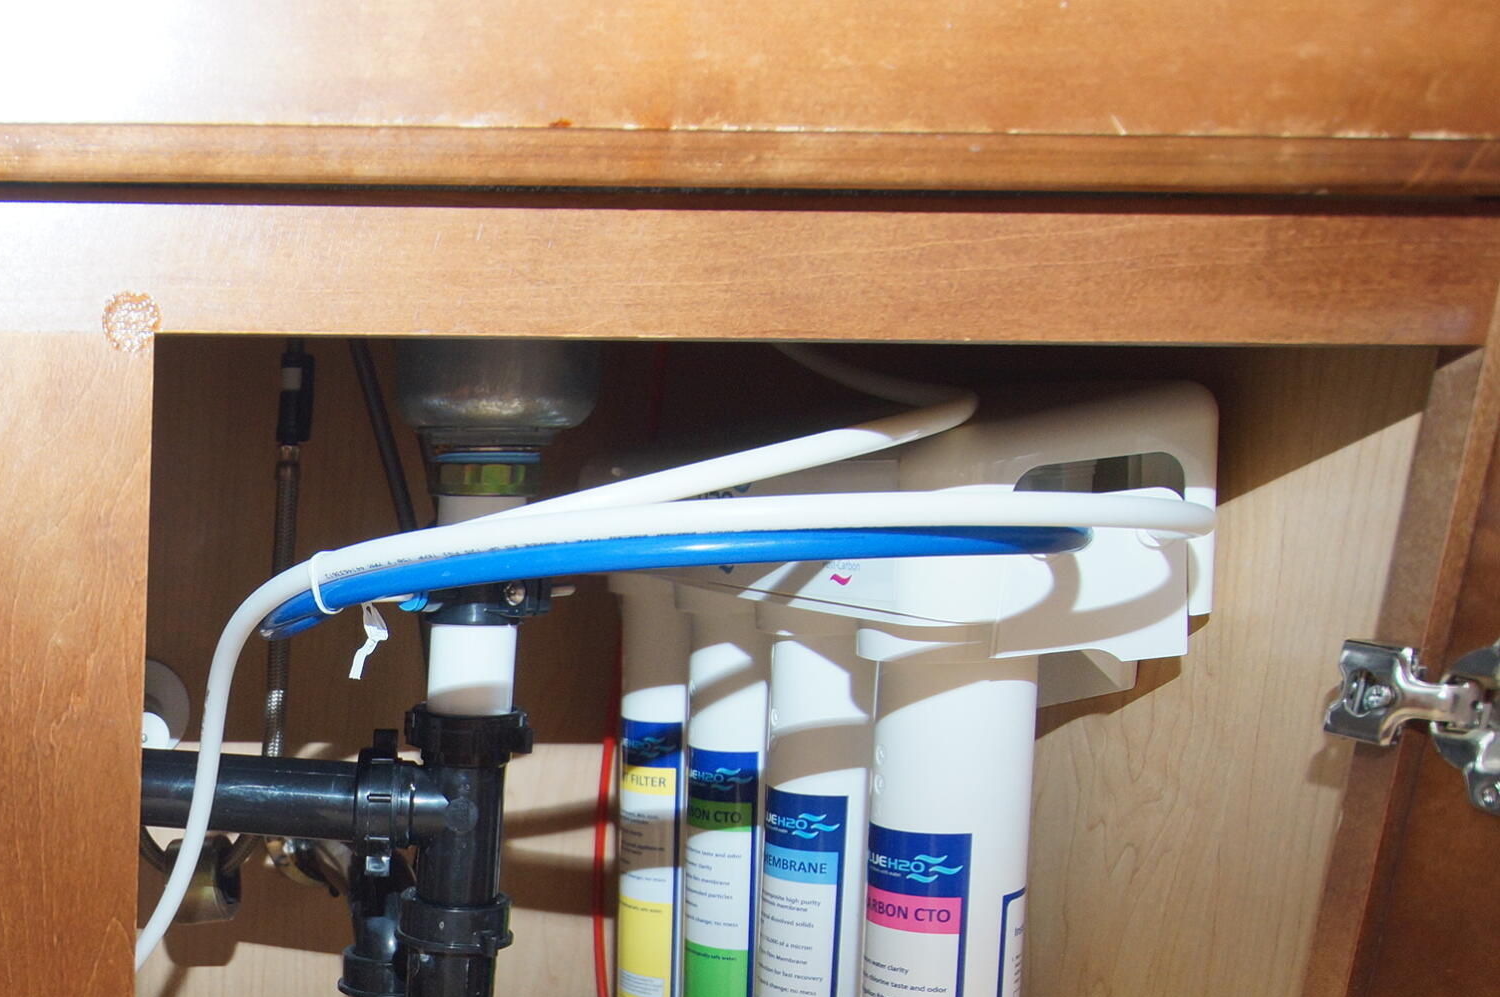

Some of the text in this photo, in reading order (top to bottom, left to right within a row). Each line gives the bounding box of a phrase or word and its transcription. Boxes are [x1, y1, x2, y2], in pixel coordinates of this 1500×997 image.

[631, 774, 667, 788] FILTER
[714, 810, 742, 824] CTO
[913, 907, 952, 924] CTO
[887, 964, 910, 976] clarity
[890, 980, 909, 991] taste
[909, 985, 926, 993] and
[926, 985, 948, 994] odor
